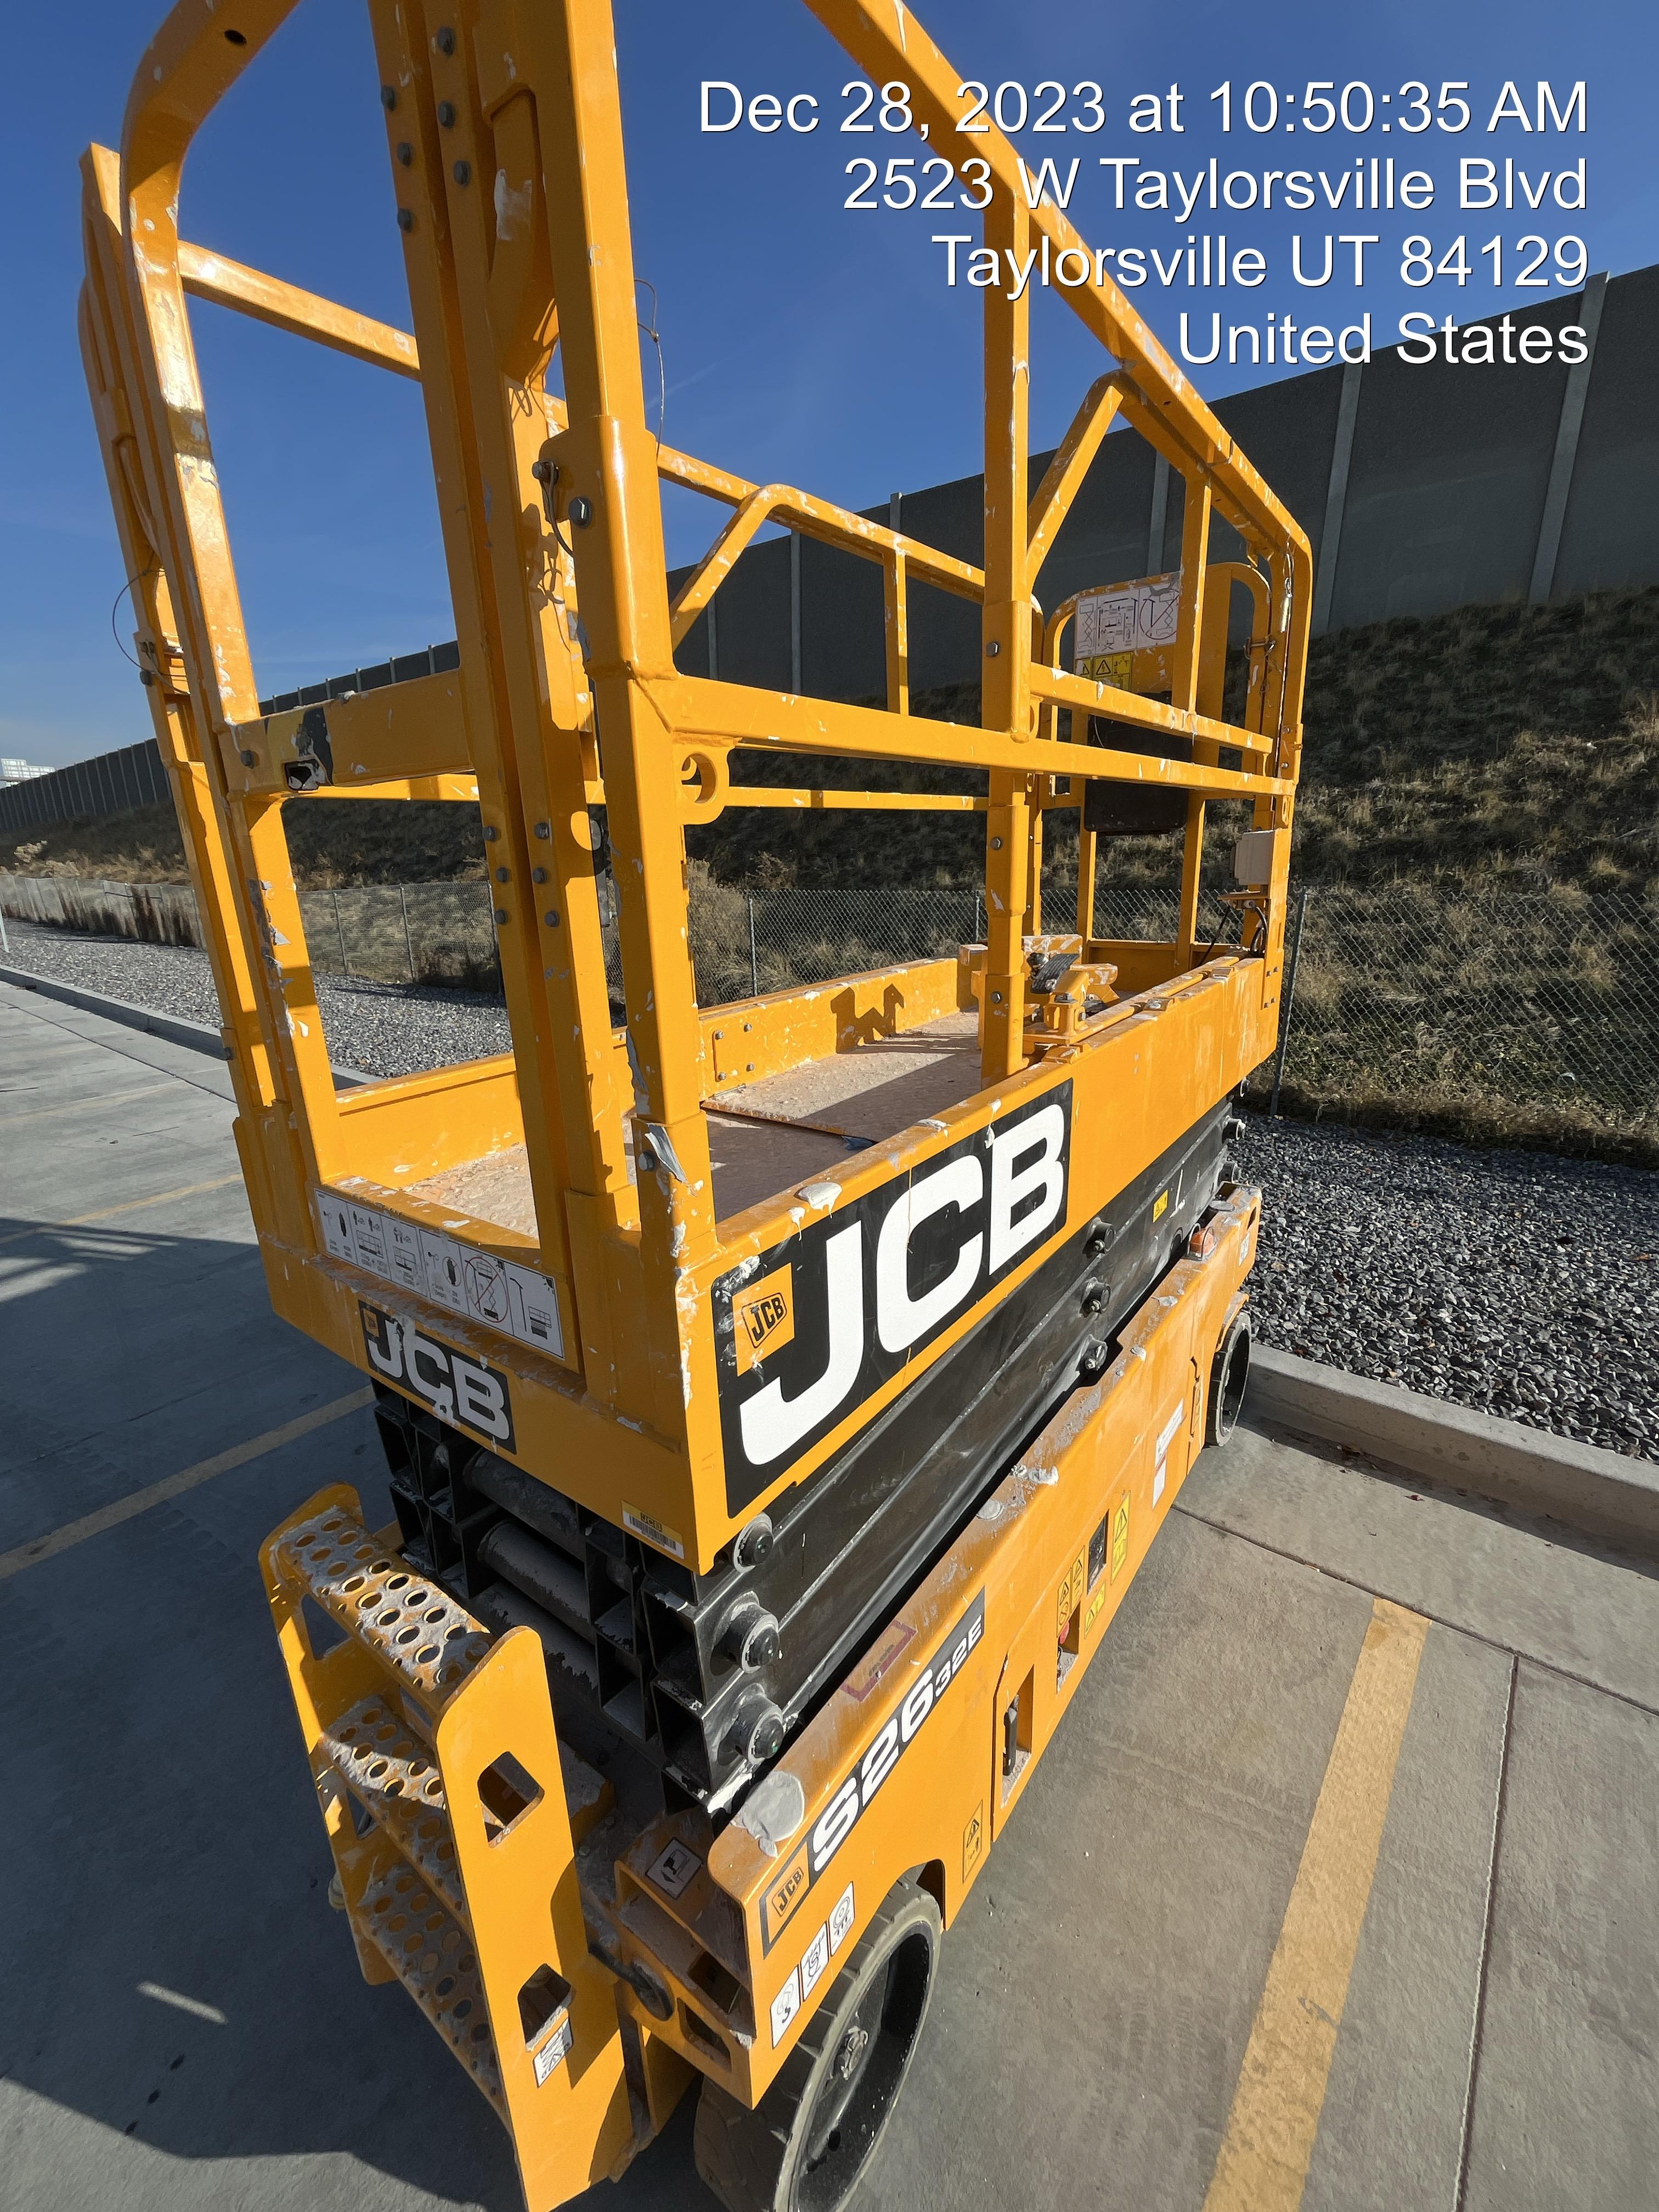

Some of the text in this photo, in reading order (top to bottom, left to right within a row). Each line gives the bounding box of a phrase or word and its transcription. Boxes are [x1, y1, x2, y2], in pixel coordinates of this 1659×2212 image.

[740, 1104, 1064, 1465] JCB
[749, 1297, 784, 1342] JCB
[368, 1319, 510, 1440] JCB
[641, 1514, 662, 1531] JCB
[778, 1870, 802, 1911] JCB
